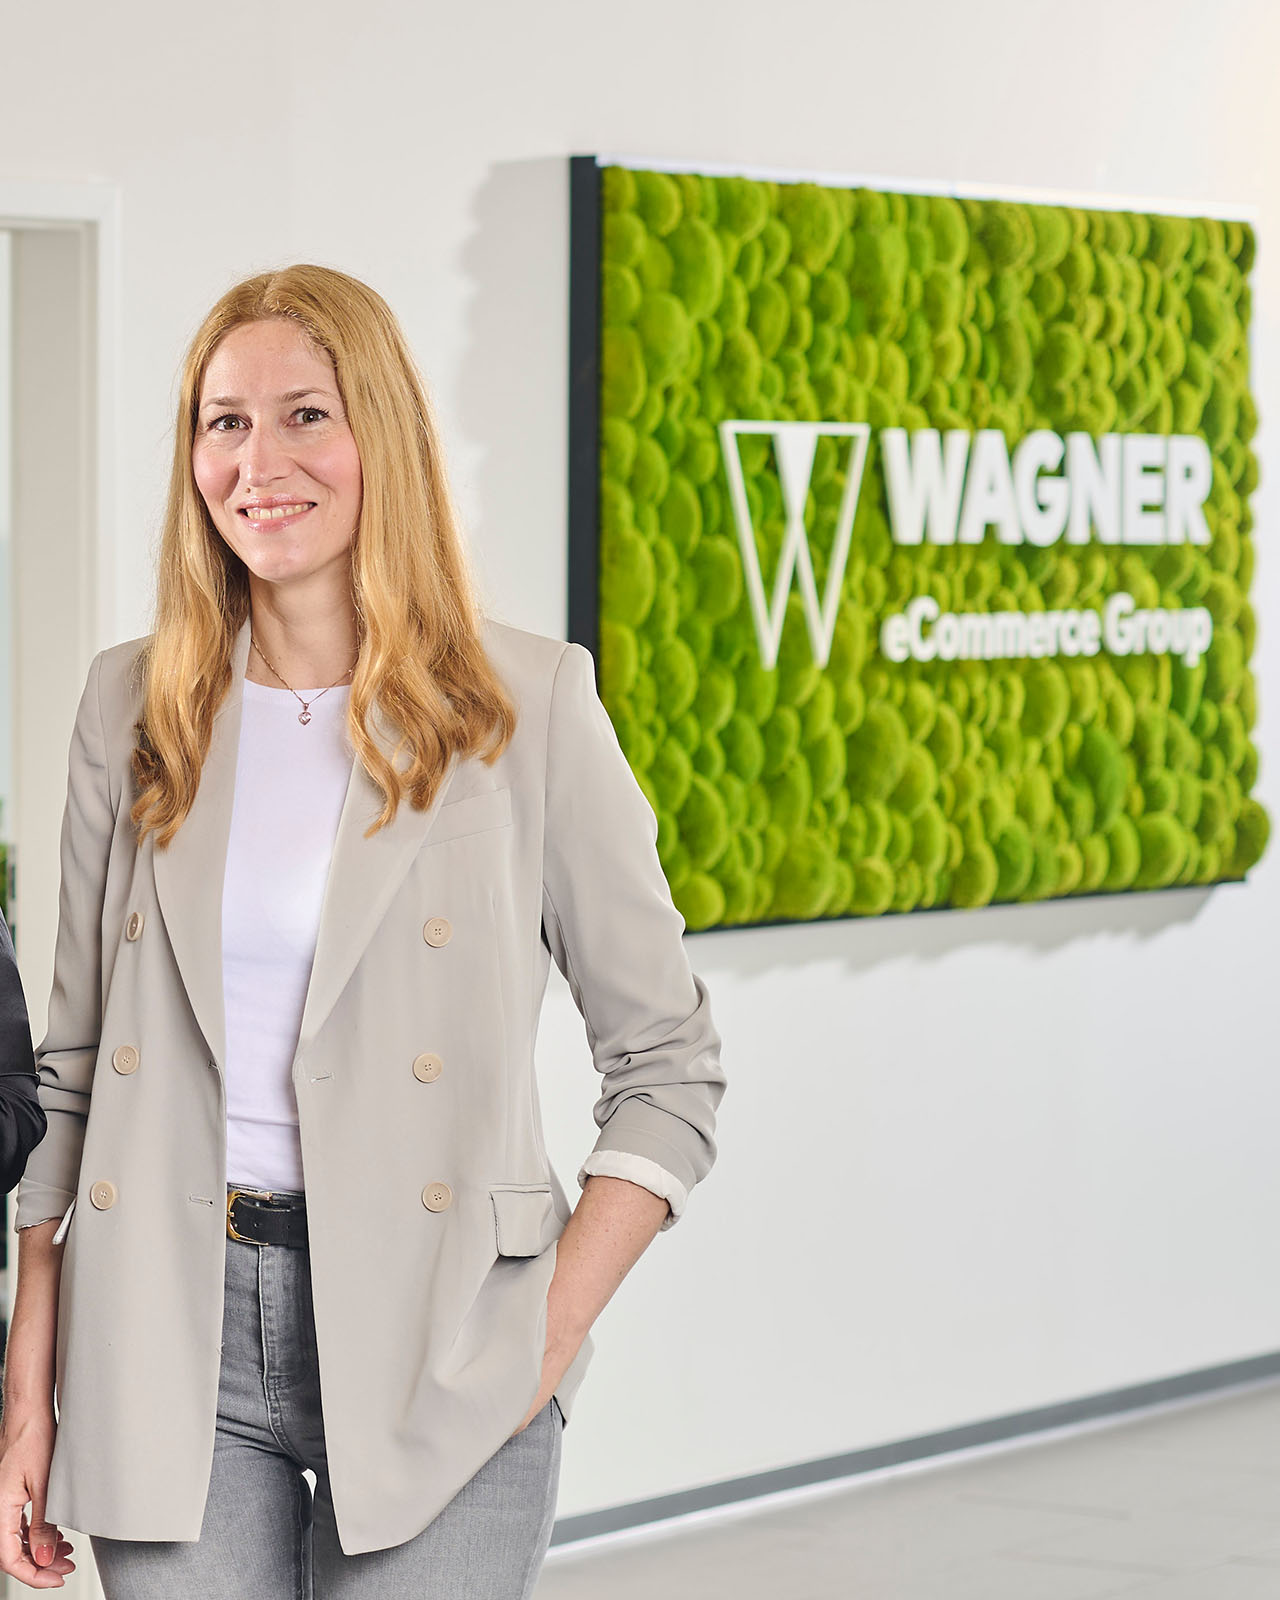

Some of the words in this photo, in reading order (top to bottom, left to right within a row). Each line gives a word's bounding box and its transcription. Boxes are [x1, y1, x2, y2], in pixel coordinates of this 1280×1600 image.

[880, 428, 1213, 547] WAGNER
[880, 594, 1102, 663] eCommerce
[1102, 591, 1213, 668] Group
